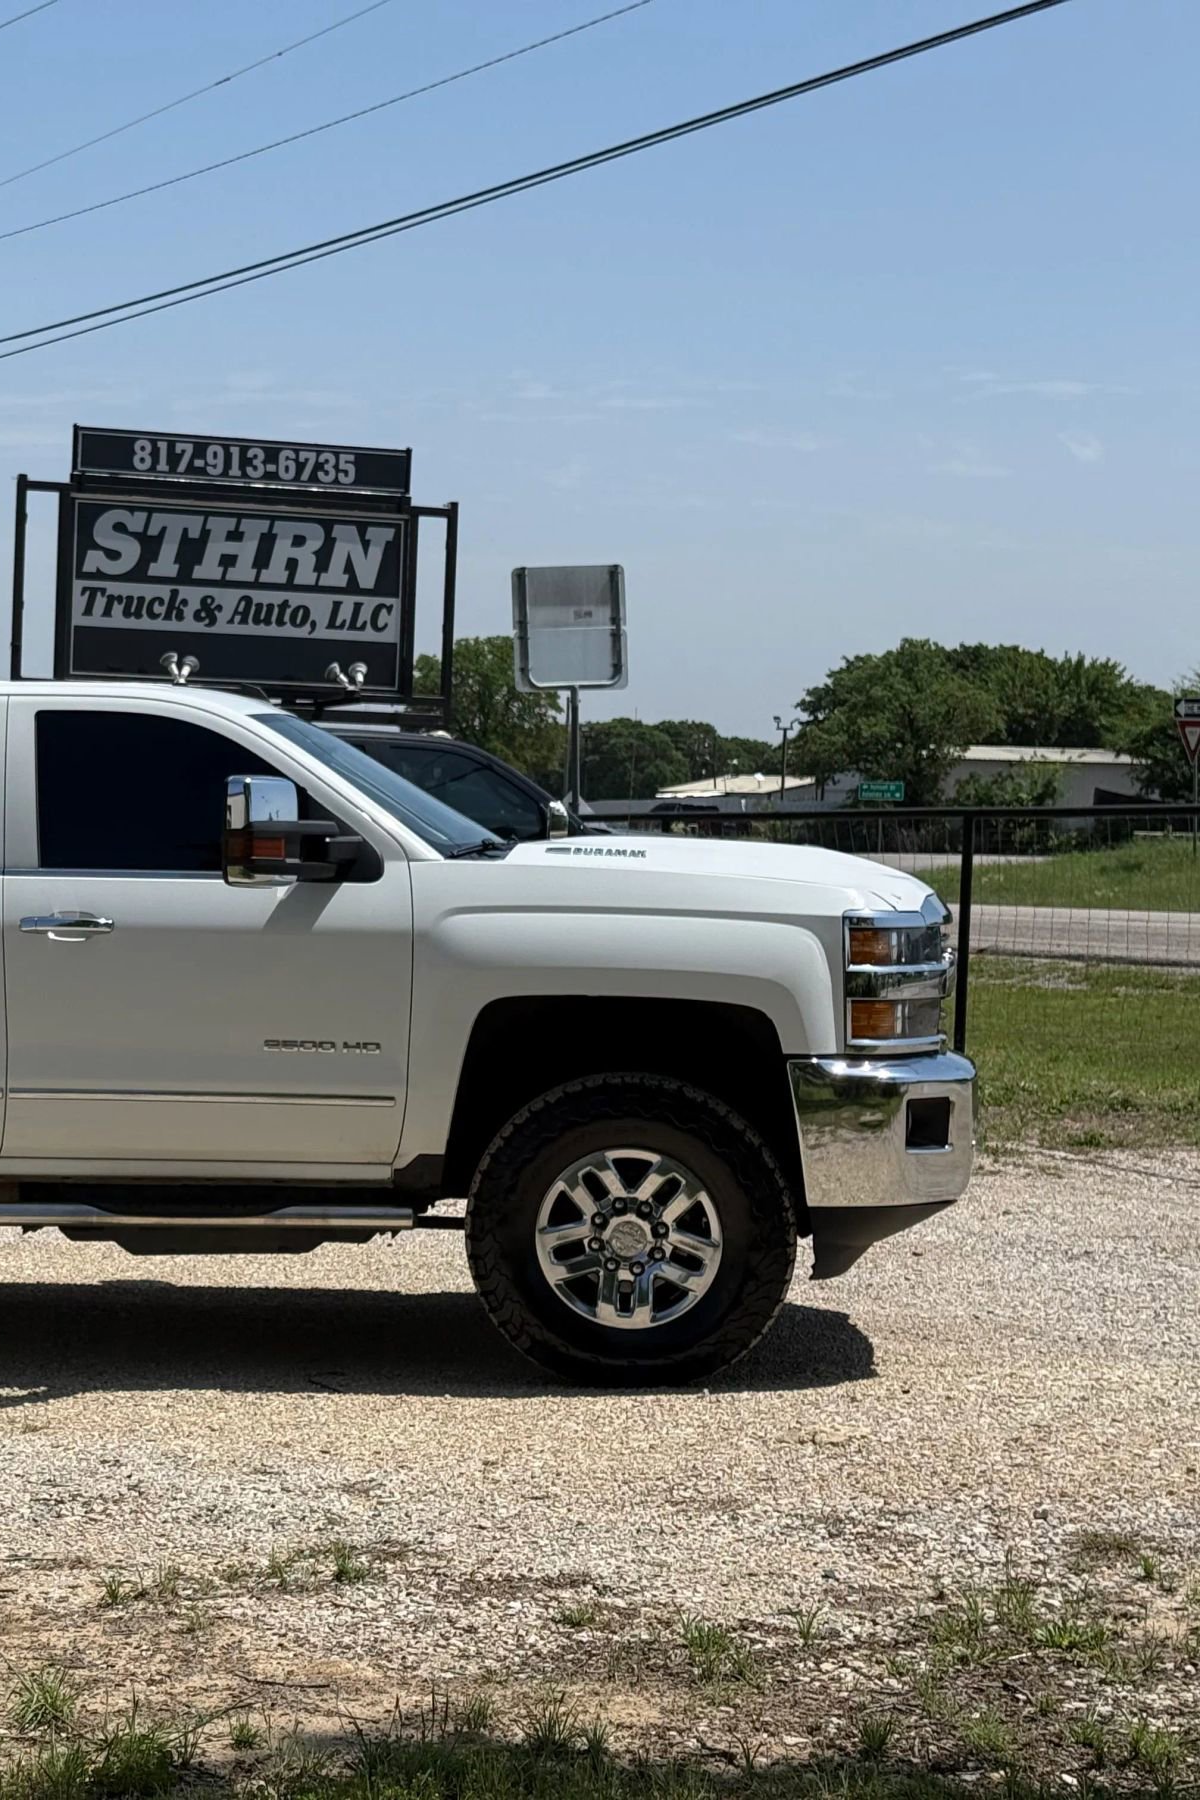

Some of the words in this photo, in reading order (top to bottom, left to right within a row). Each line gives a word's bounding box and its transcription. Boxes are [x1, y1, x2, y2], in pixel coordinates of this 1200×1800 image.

[132, 438, 356, 485] 817-913-6735
[82, 509, 395, 589] STHRN
[80, 586, 189, 624] Truck
[193, 595, 223, 628] &
[226, 594, 317, 635] Auto,
[325, 602, 394, 633] LLC
[572, 847, 647, 858] DURAMAX
[342, 1041, 381, 1054] HD
